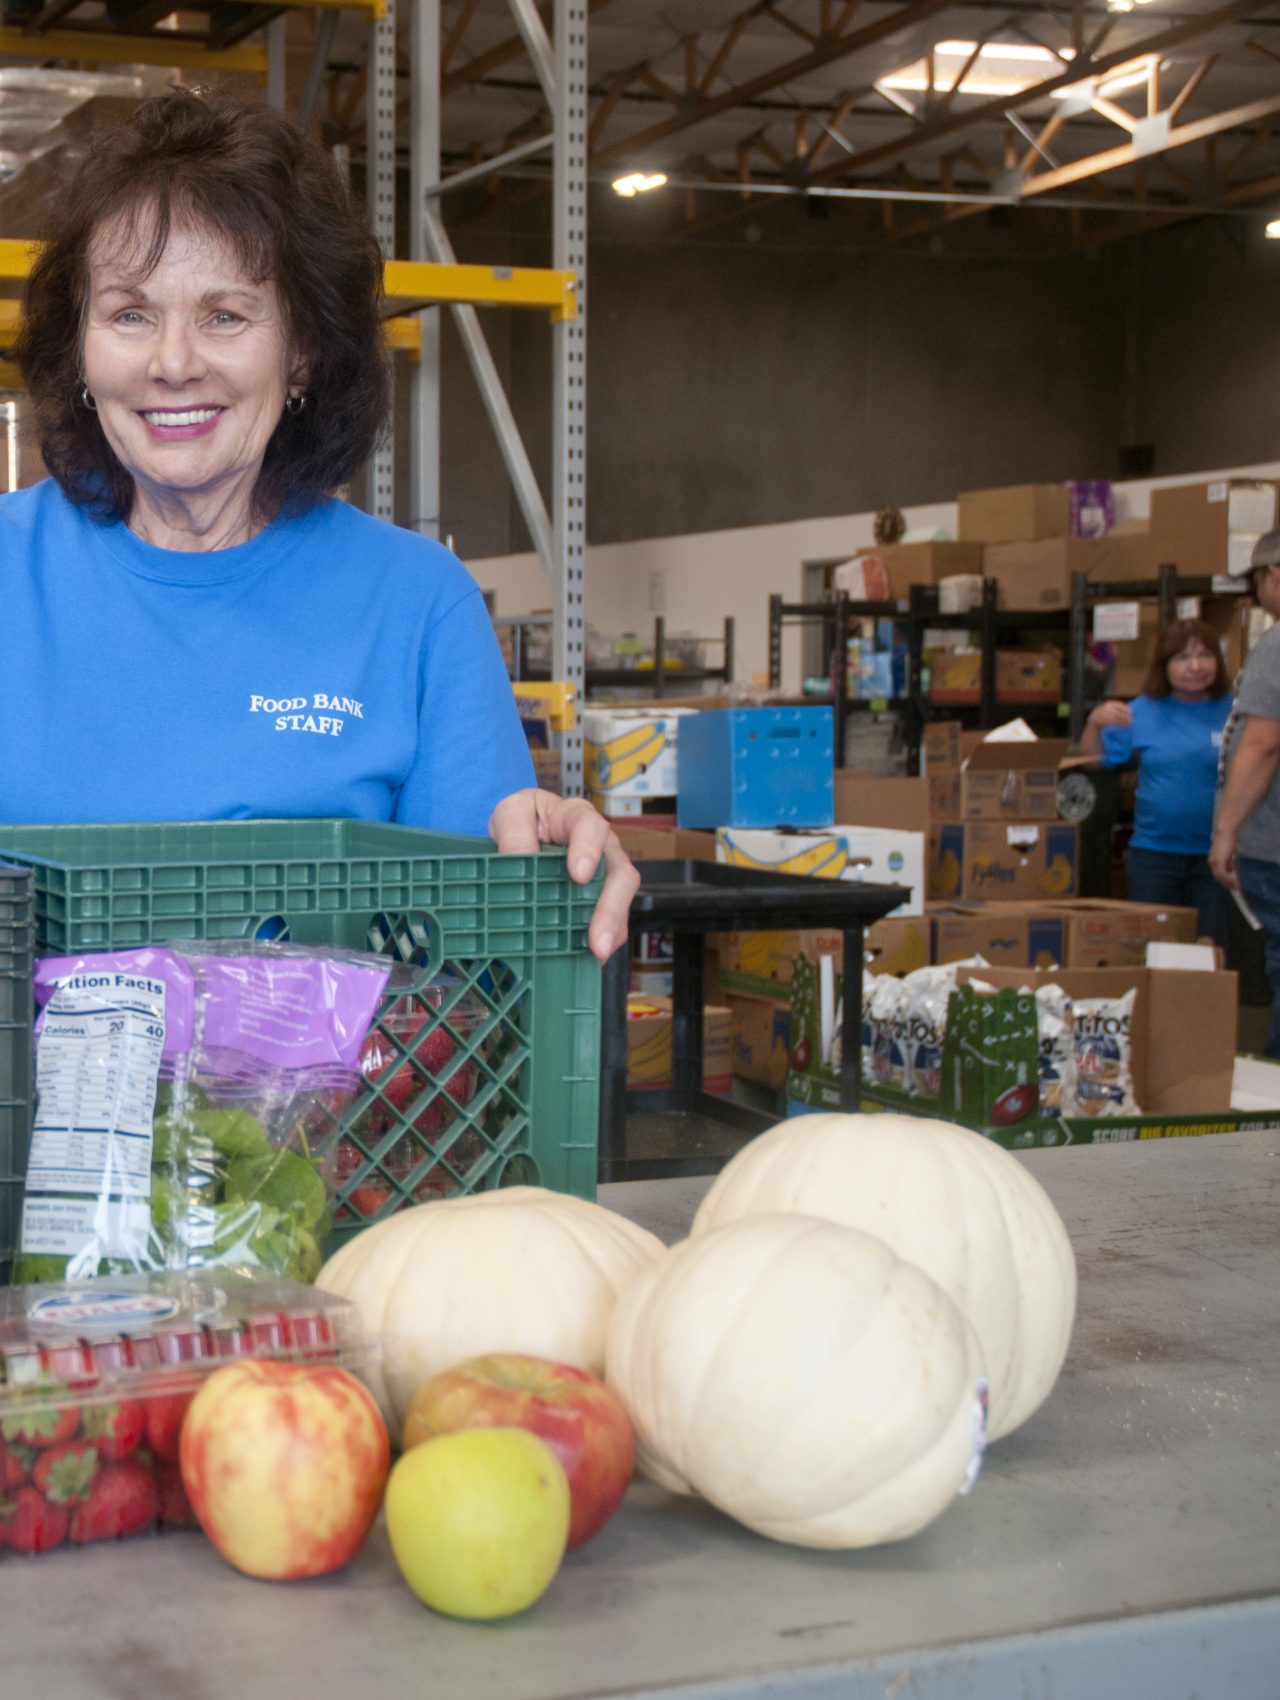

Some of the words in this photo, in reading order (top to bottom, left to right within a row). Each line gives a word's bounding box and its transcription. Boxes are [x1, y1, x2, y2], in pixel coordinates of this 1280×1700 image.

[249, 694, 308, 713] FOOD
[312, 693, 364, 720] BANK
[274, 714, 344, 737] STAFF
[115, 975, 163, 995] Facts
[45, 1025, 85, 1035] Calories
[109, 1021, 125, 1033] 20
[146, 1025, 164, 1038] 40
